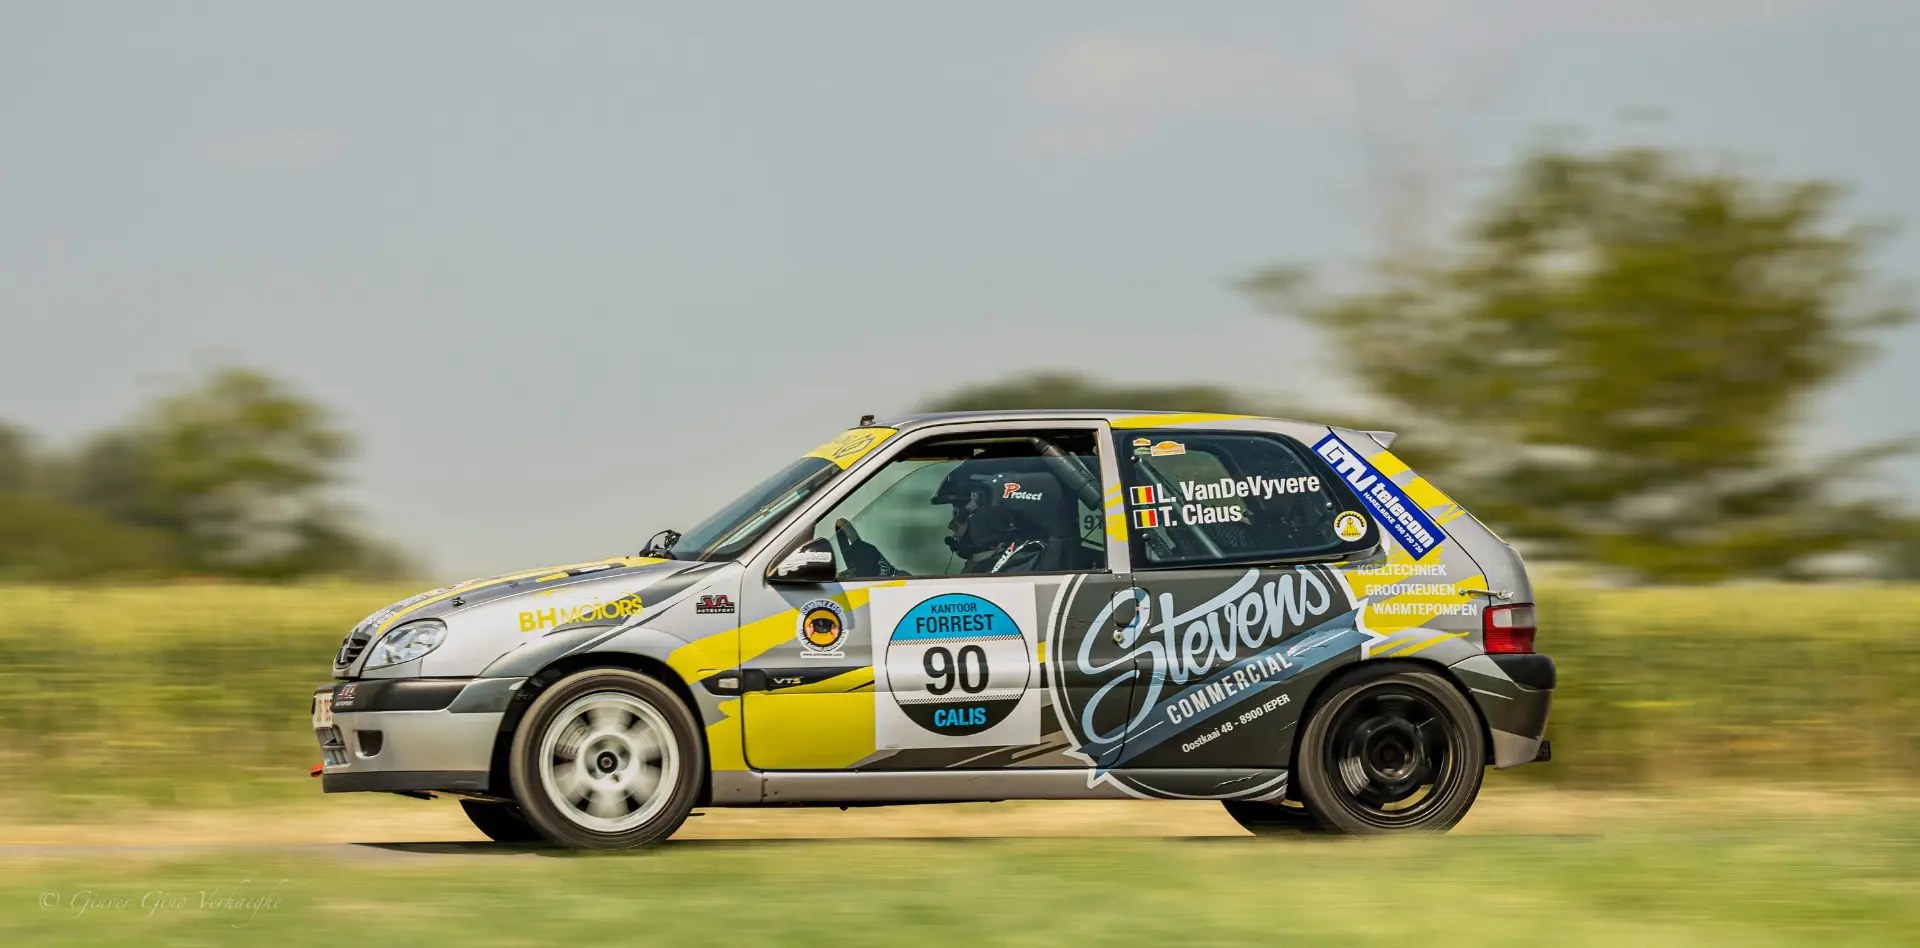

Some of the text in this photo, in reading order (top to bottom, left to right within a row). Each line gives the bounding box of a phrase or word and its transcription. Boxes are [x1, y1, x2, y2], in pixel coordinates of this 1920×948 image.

[1003, 483, 1043, 501] Protect
[1156, 475, 1320, 503] L. VanDeVyvere
[1159, 505, 1243, 527] T. Claus
[1363, 492, 1395, 524] HARELBEKE
[1371, 482, 1435, 549] telecom
[1356, 563, 1448, 576] KOELTECHNIEK
[1365, 583, 1456, 596] GROOTKEUKEN
[519, 596, 644, 632] BH MOTORS
[931, 603, 977, 614] KANTOOR
[1372, 603, 1478, 616] WARMTEPOMPEN
[916, 614, 994, 634] FORREST
[1077, 565, 1331, 745] Stevens
[923, 645, 989, 696] 90
[1166, 652, 1293, 724] COMMERCIAL
[934, 707, 987, 727] CALIS
[1182, 728, 1221, 753] Oostkaai
[1221, 721, 1234, 733] 48
[1239, 707, 1264, 725] 8900
[1262, 693, 1291, 713] IEPER
